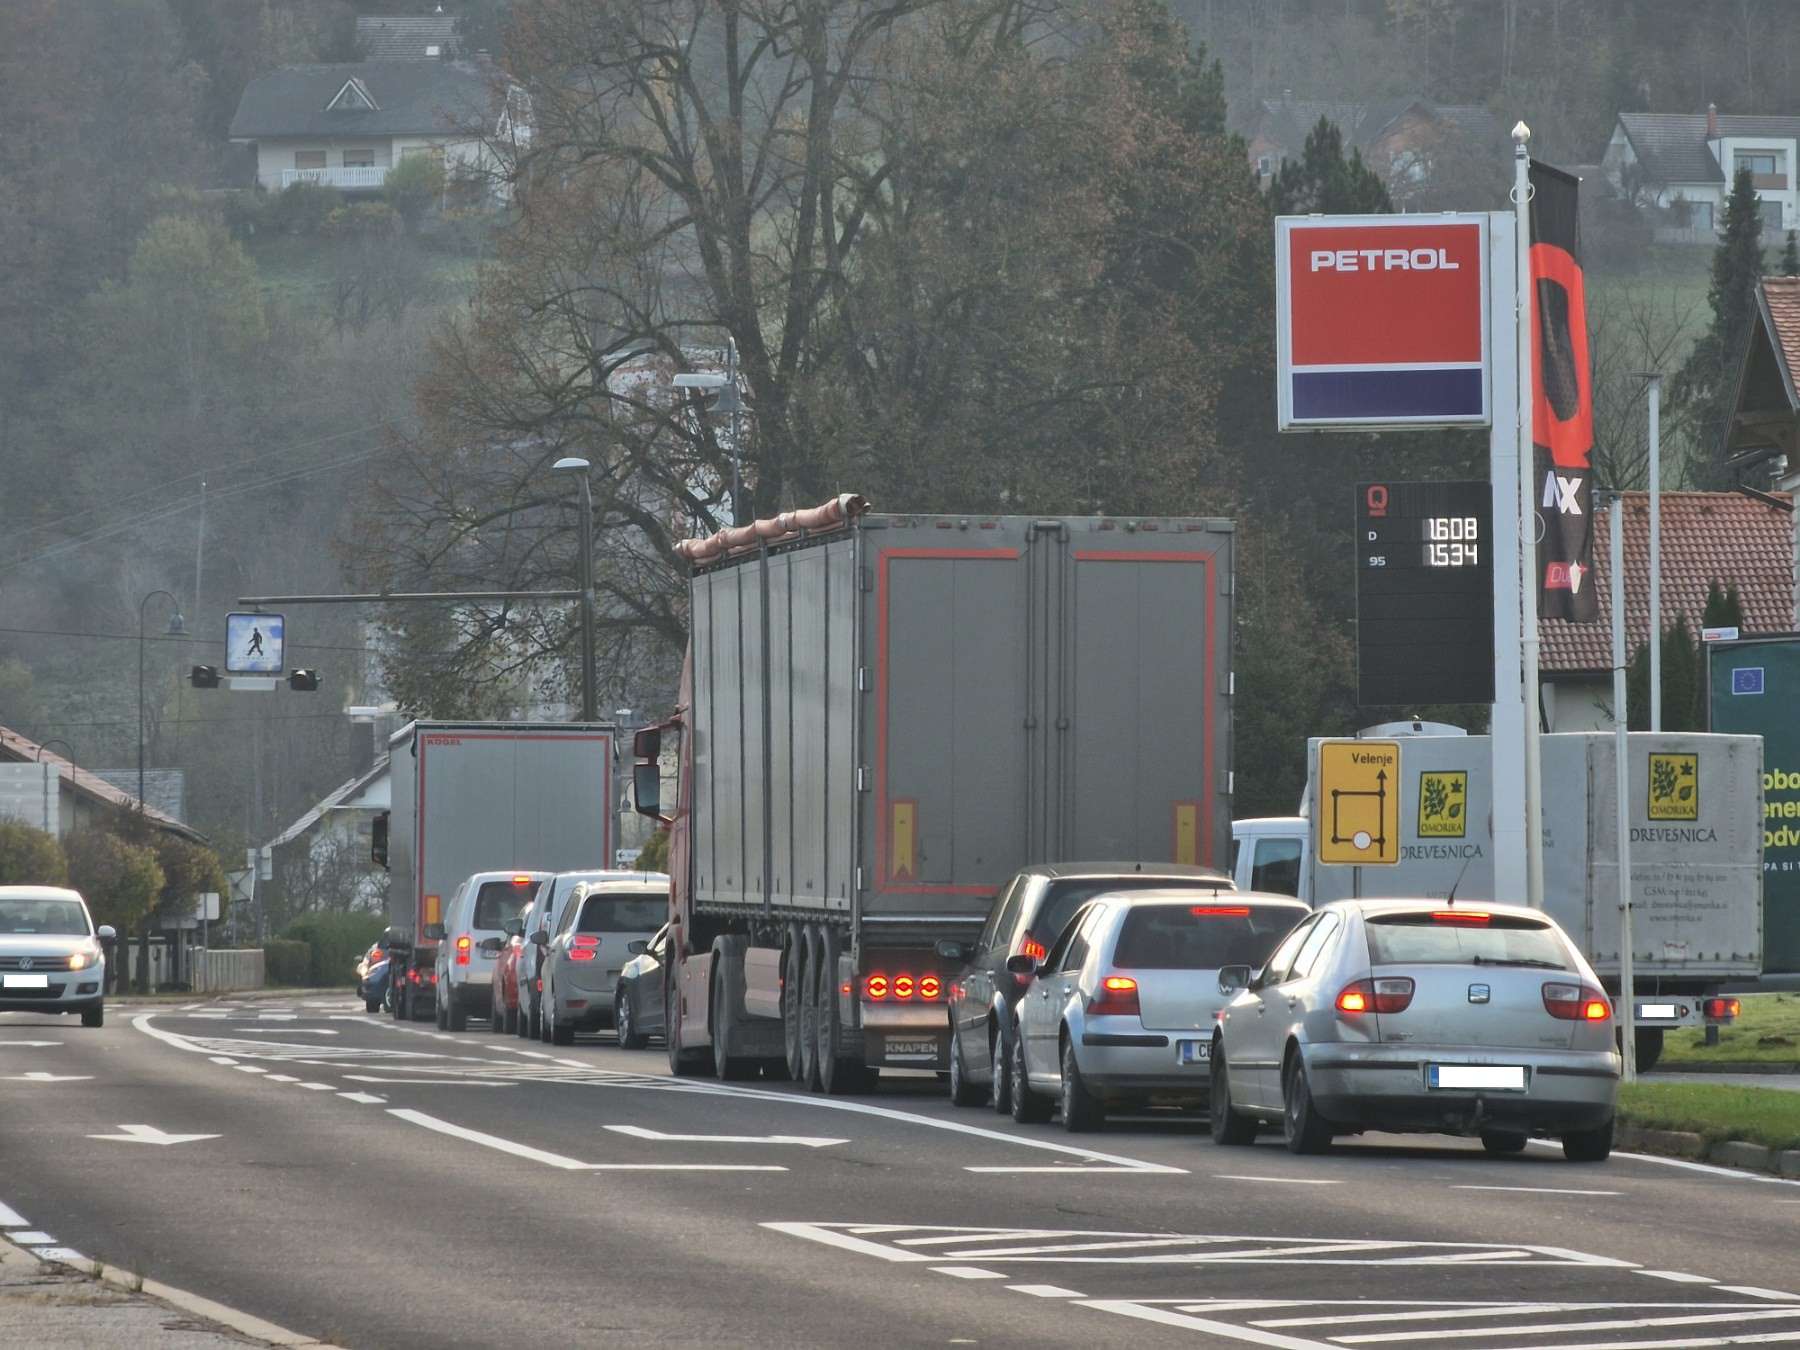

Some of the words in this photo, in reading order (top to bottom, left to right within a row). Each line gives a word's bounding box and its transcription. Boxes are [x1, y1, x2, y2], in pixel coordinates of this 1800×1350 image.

[1311, 248, 1459, 272] PETROL
[1368, 531, 1377, 541] D
[1369, 556, 1386, 567] 95
[1352, 752, 1393, 767] Velenje
[1651, 806, 1695, 815] OMORIKA
[1421, 823, 1462, 833] OMORIKA
[1629, 828, 1718, 842] DREVESNICA
[1782, 862, 1793, 871] SI
[885, 1043, 938, 1053] KNAPEN
